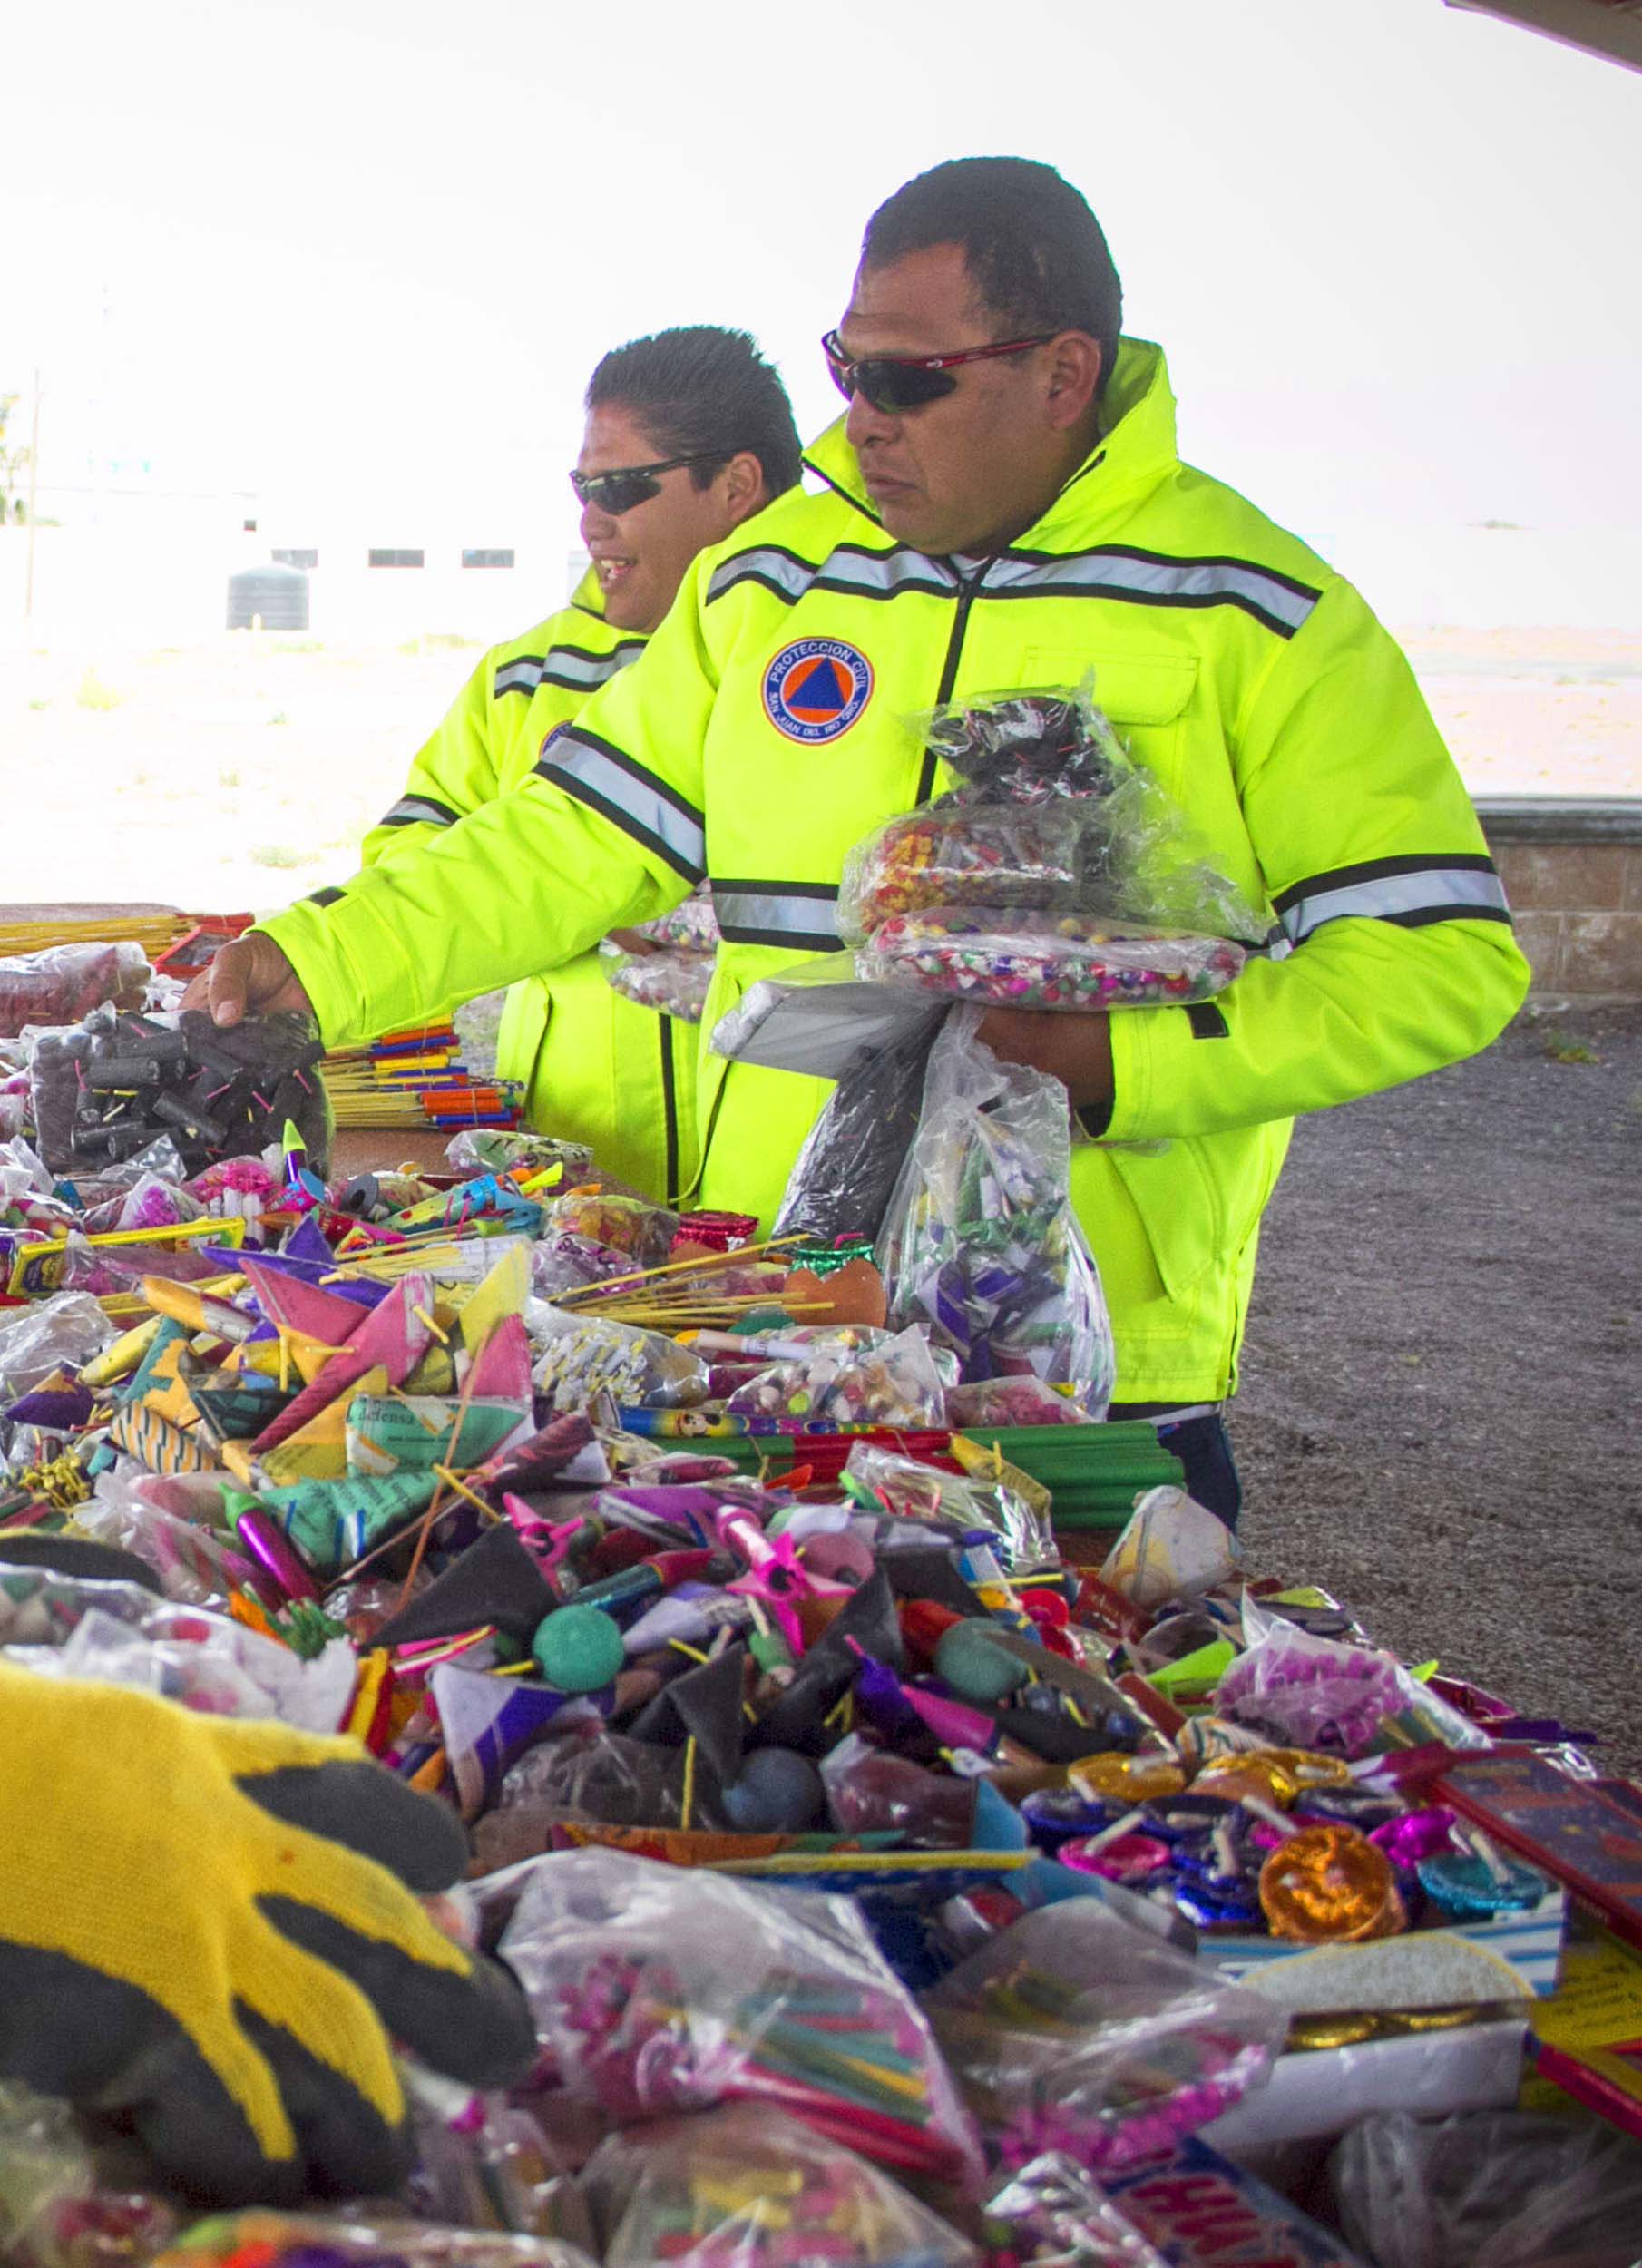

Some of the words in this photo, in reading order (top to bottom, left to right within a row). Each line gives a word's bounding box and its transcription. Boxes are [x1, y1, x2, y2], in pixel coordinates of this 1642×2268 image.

[769, 641, 852, 683] PROTECCION
[852, 661, 867, 692] CIVIL
[768, 691, 779, 712] SAN
[776, 714, 801, 734] JUAN
[803, 727, 821, 737] DEL
